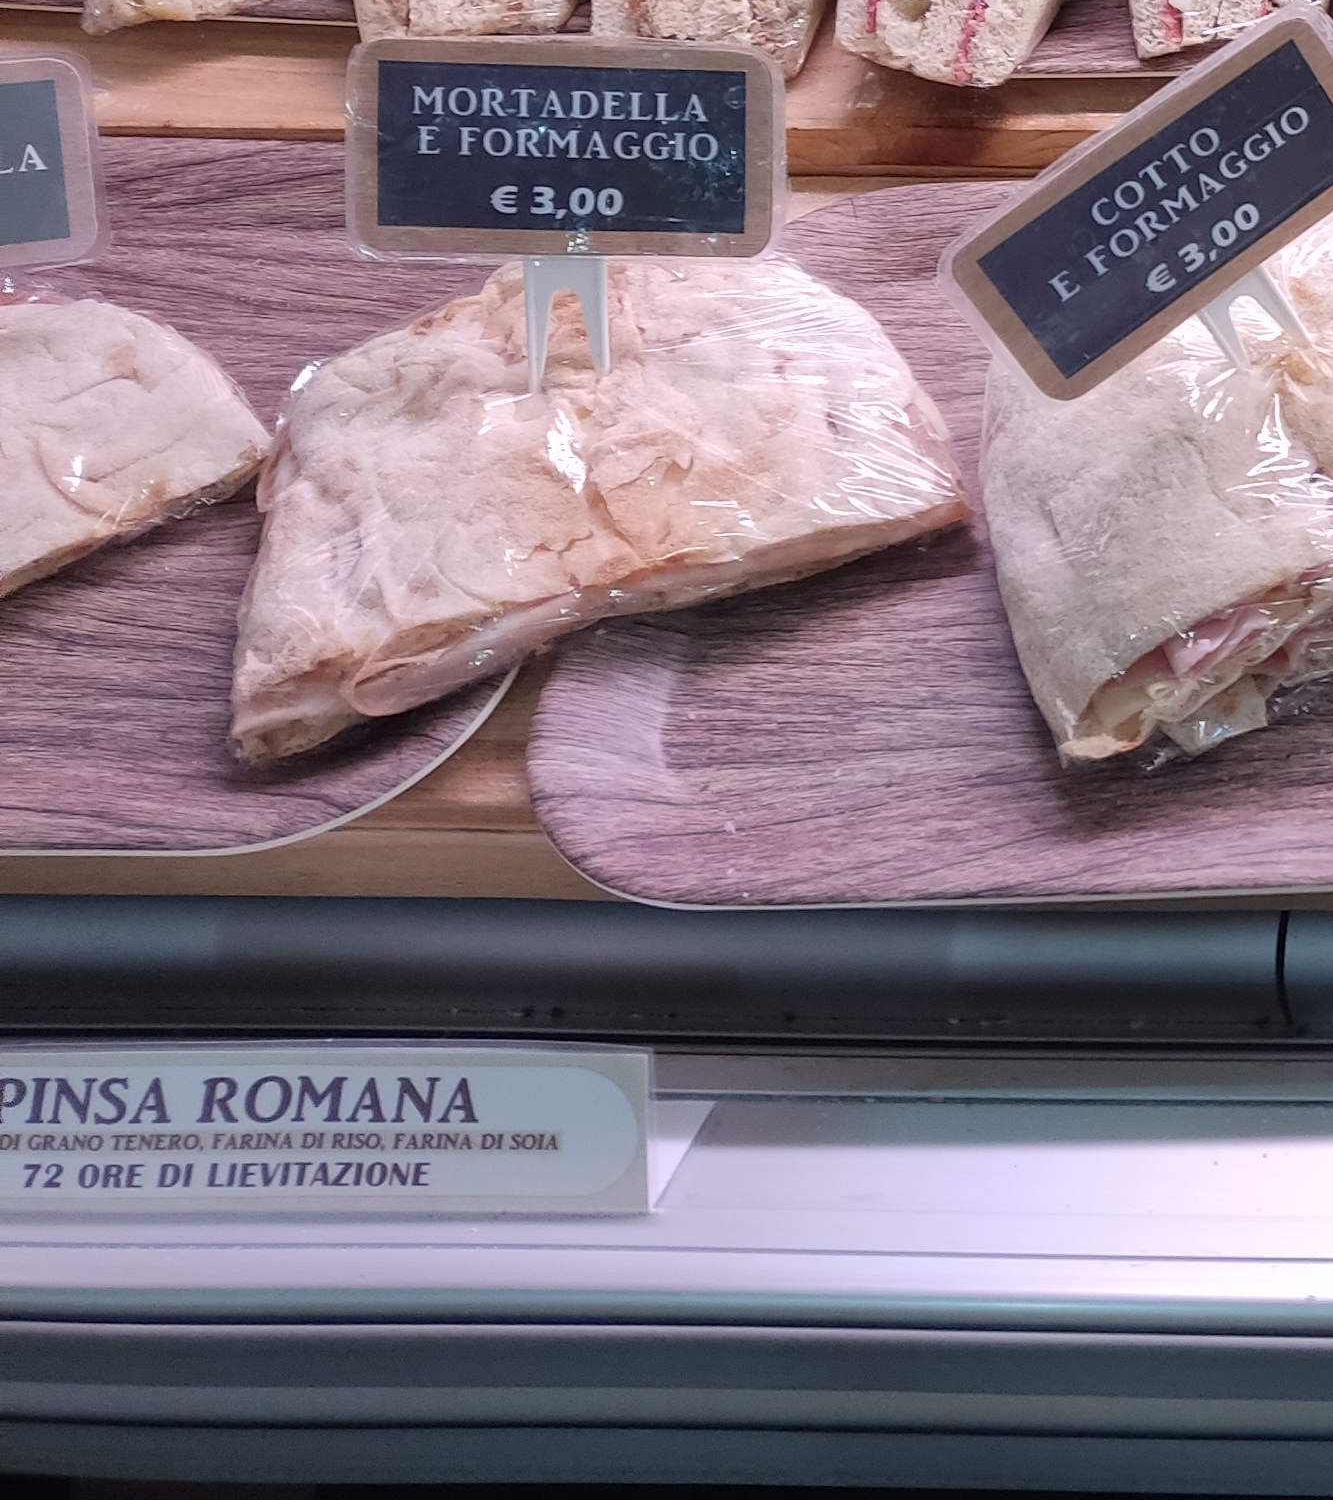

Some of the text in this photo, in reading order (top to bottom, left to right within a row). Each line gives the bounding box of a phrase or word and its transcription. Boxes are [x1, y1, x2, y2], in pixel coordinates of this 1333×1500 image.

[411, 85, 709, 122] MORTADELLA
[417, 126, 719, 162] E FORMAGGIO
[1091, 126, 1221, 227] COTTO
[491, 186, 624, 220] € 3,00
[1048, 105, 1310, 303] E FORMAGGIO
[1146, 203, 1259, 293] € 3,00
[197, 1076, 480, 1124] ROMANA
[27, 1134, 104, 1151] GRANO
[112, 1134, 204, 1153] TENERO,
[211, 1132, 294, 1150] FARINA
[302, 1133, 325, 1151] DI
[332, 1132, 386, 1152] RISO,
[393, 1132, 475, 1150] FARINA
[481, 1132, 503, 1150] DI
[509, 1132, 558, 1150] SOIA
[22, 1163, 431, 1189] 72 ORE DI LIEVITAZIONE
